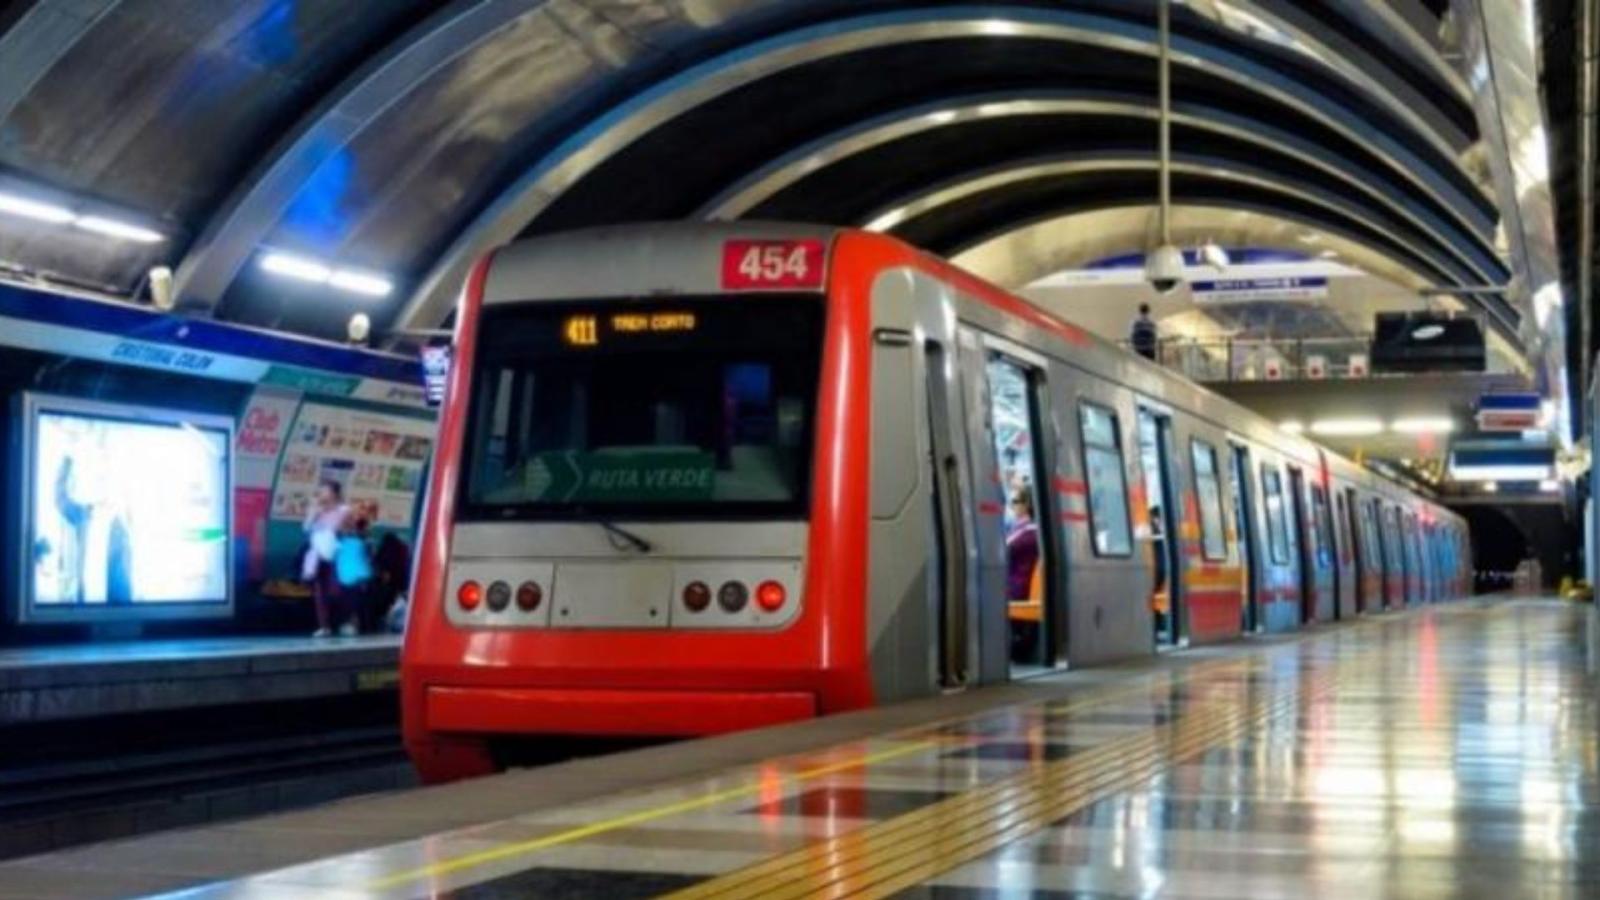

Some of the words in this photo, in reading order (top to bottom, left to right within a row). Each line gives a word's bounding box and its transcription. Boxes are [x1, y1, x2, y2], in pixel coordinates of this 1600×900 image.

[739, 244, 809, 281] 454
[613, 315, 648, 330] TREN
[651, 313, 695, 330] CORTO
[245, 406, 280, 432] Club
[235, 428, 280, 455] Metro
[588, 469, 640, 489] RUTA
[645, 468, 713, 489] VERDE
